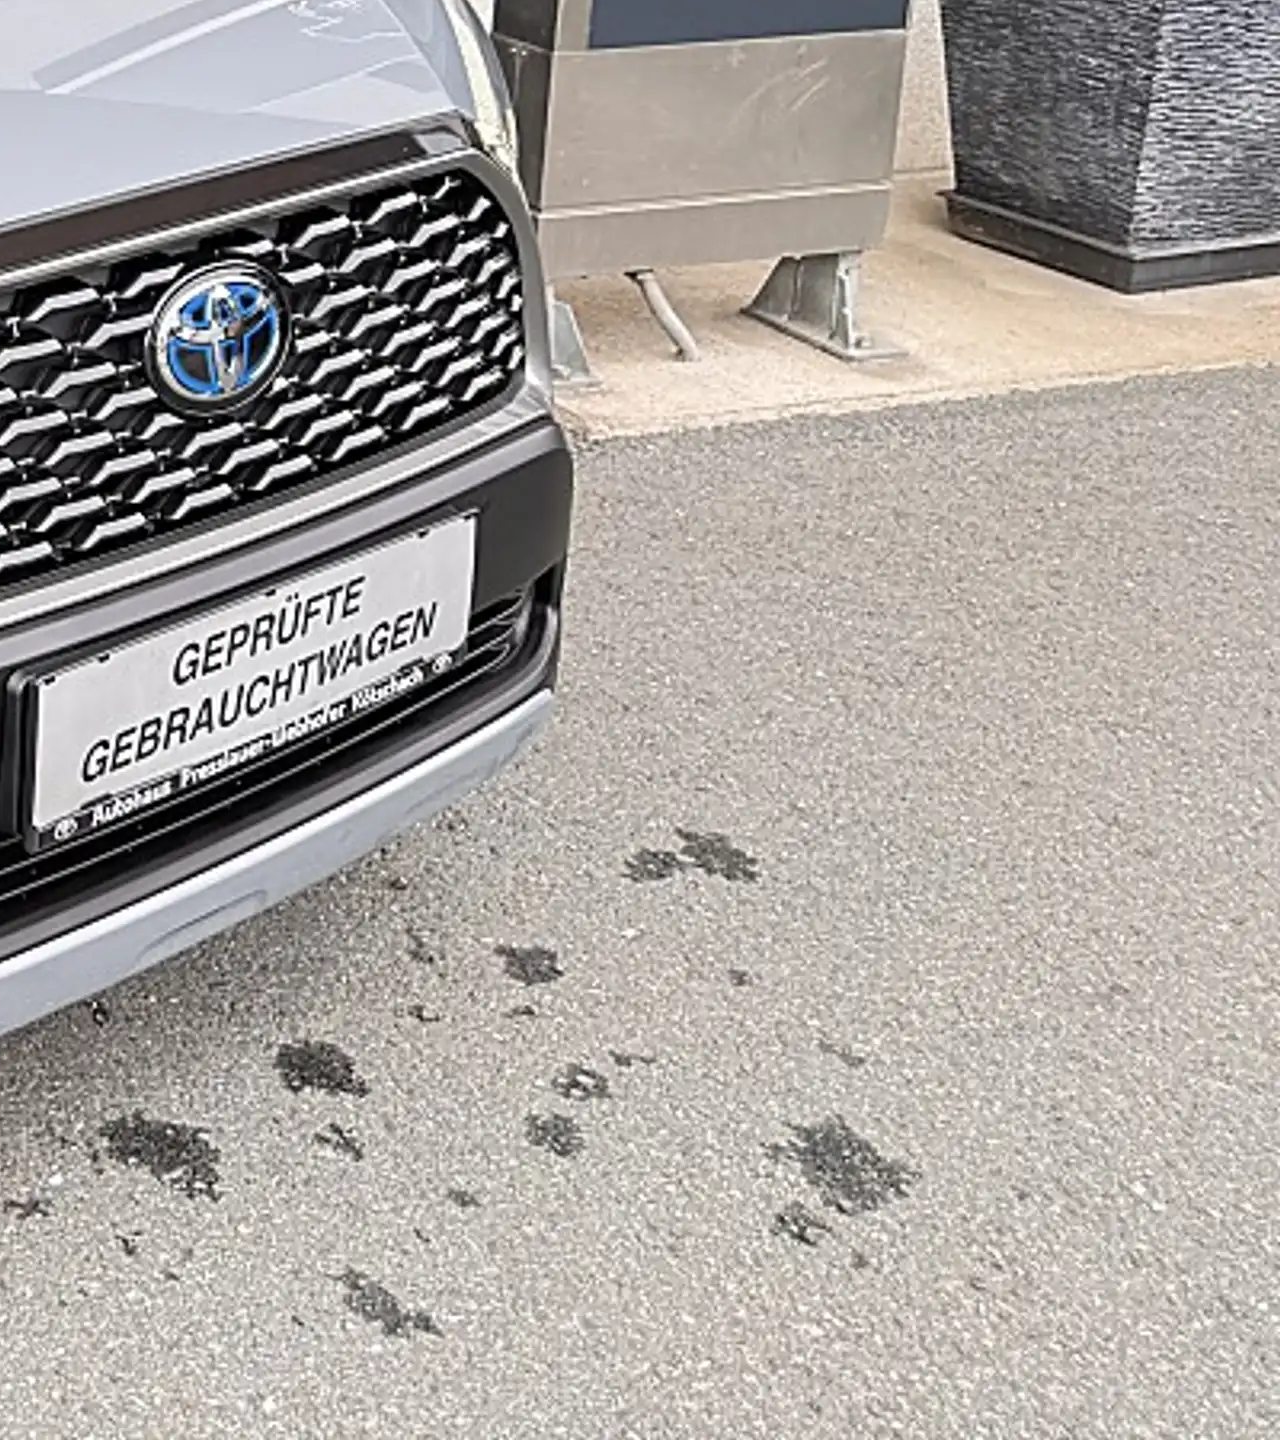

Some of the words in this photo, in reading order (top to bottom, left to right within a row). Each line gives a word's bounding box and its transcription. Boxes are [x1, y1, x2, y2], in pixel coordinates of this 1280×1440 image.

[172, 575, 366, 687] GEPRÜFTE
[80, 601, 439, 784] GEBRAUCHTWAGEN
[91, 781, 172, 828] Autohaus
